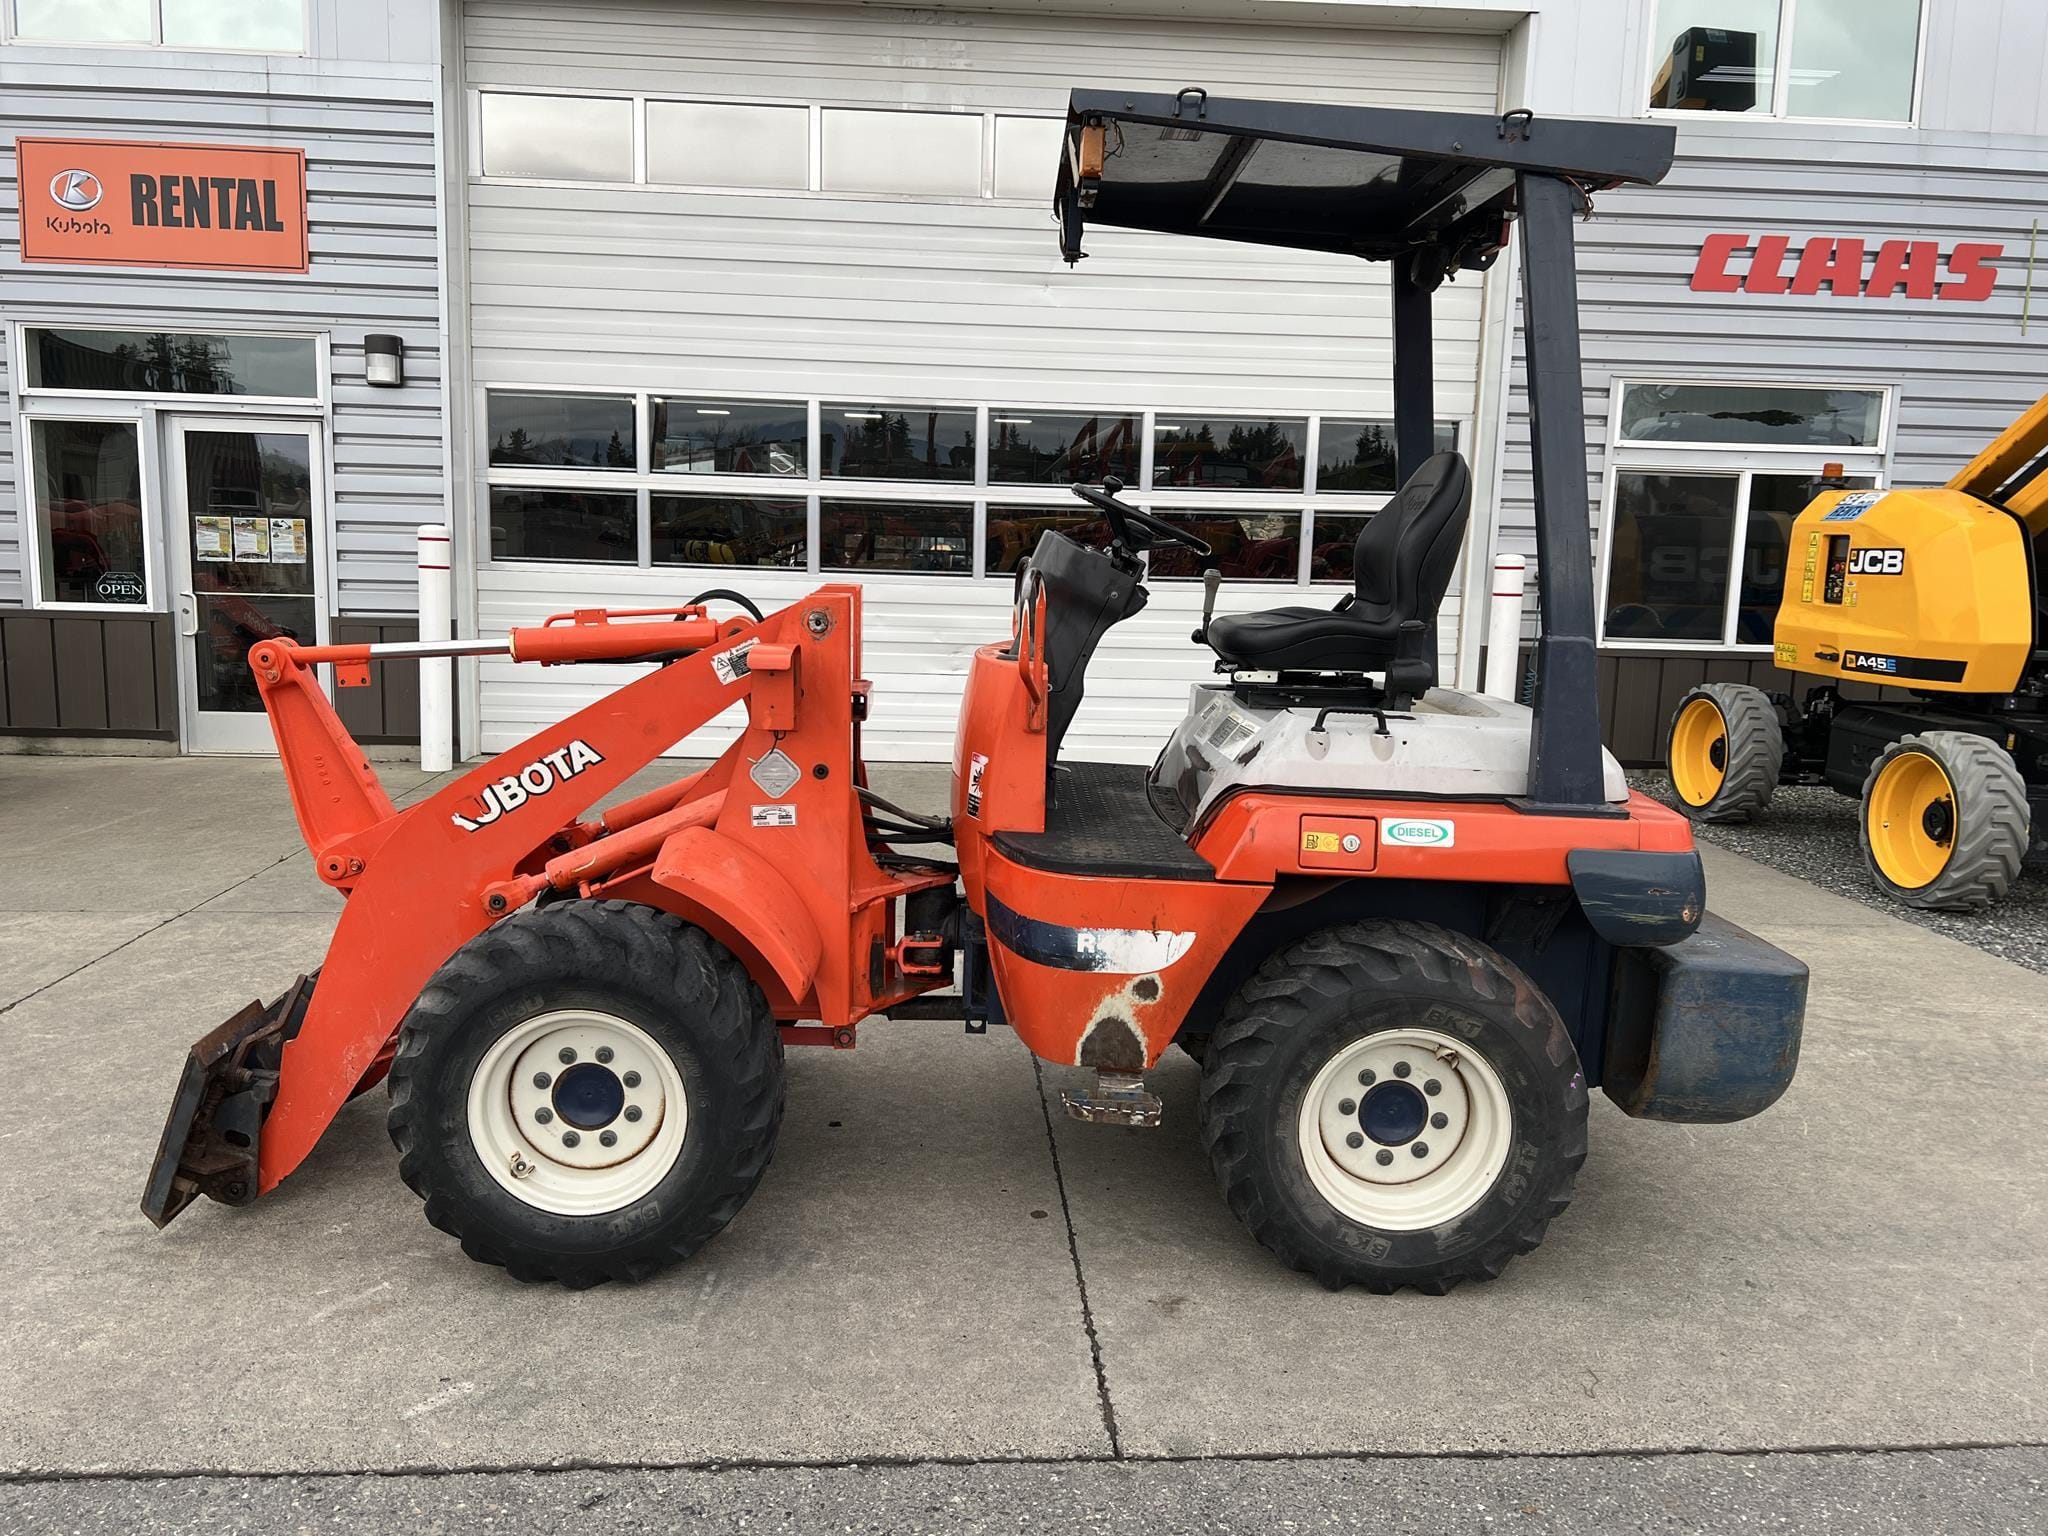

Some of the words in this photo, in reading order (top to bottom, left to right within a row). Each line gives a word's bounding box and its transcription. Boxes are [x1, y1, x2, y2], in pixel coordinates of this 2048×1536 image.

[130, 173, 284, 232] RENTAL
[46, 216, 111, 235] Kubota
[1690, 234, 2004, 301] CLAAS
[1849, 549, 1904, 574] JCB
[98, 583, 143, 595] OPEN
[1856, 655, 1897, 670] A45E
[1397, 827, 1439, 839] DIESEL
